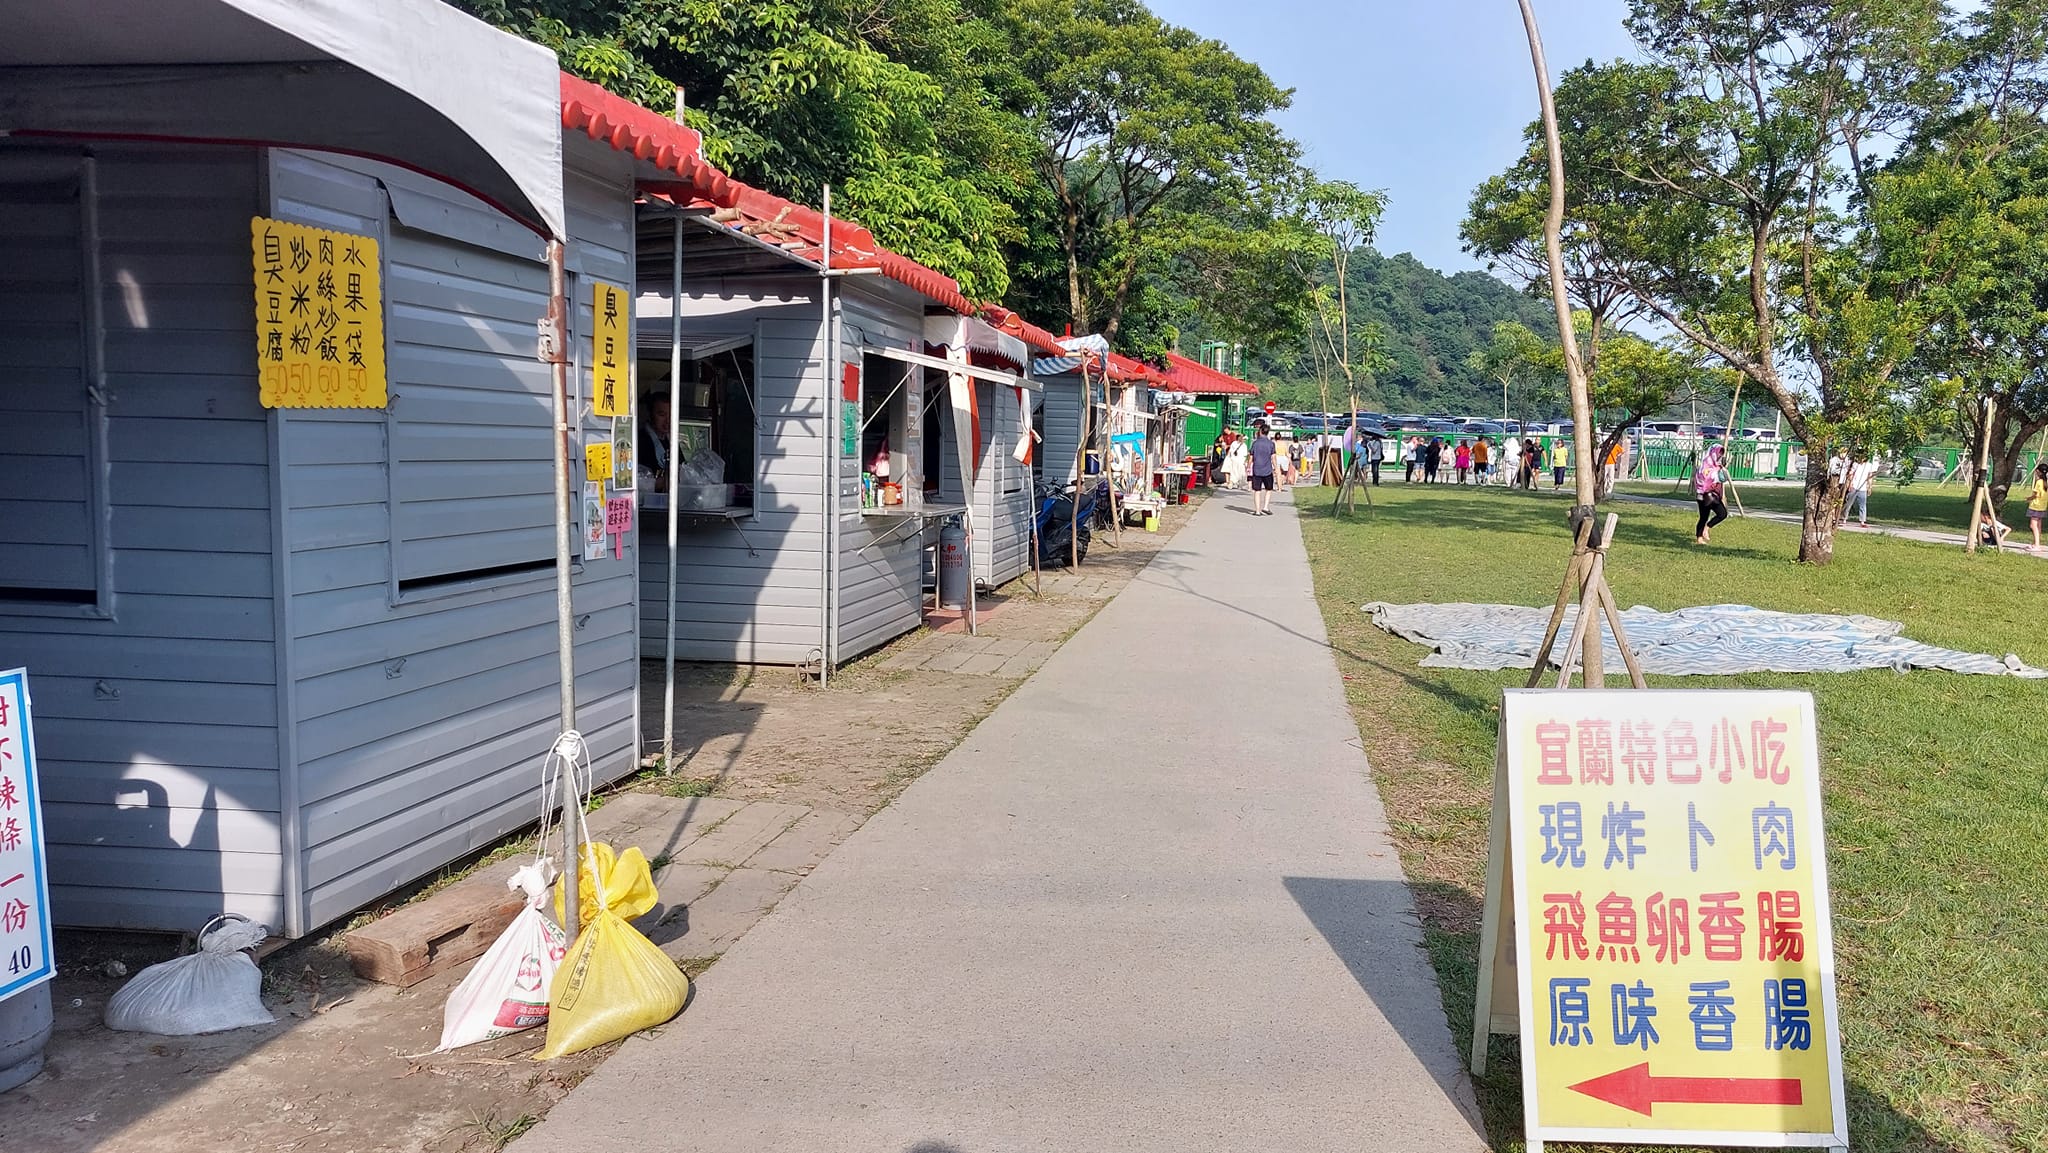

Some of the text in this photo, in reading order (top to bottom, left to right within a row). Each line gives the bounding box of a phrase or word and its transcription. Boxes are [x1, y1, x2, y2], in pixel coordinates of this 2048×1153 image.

[263, 226, 285, 362] 臭豆腐
[289, 235, 313, 355] 炒米粉
[314, 235, 342, 364] 肉絲炒飯
[342, 239, 368, 369] 水果一袋
[601, 286, 618, 413] 臭豆腐
[1535, 717, 1790, 786] 宜蘭特色小吃
[1538, 800, 1797, 873] 現炸卜肉
[8, 945, 32, 975] 40
[1542, 889, 1805, 965] 飛魚卵香腸
[1548, 977, 1812, 1052] 原味香腸
